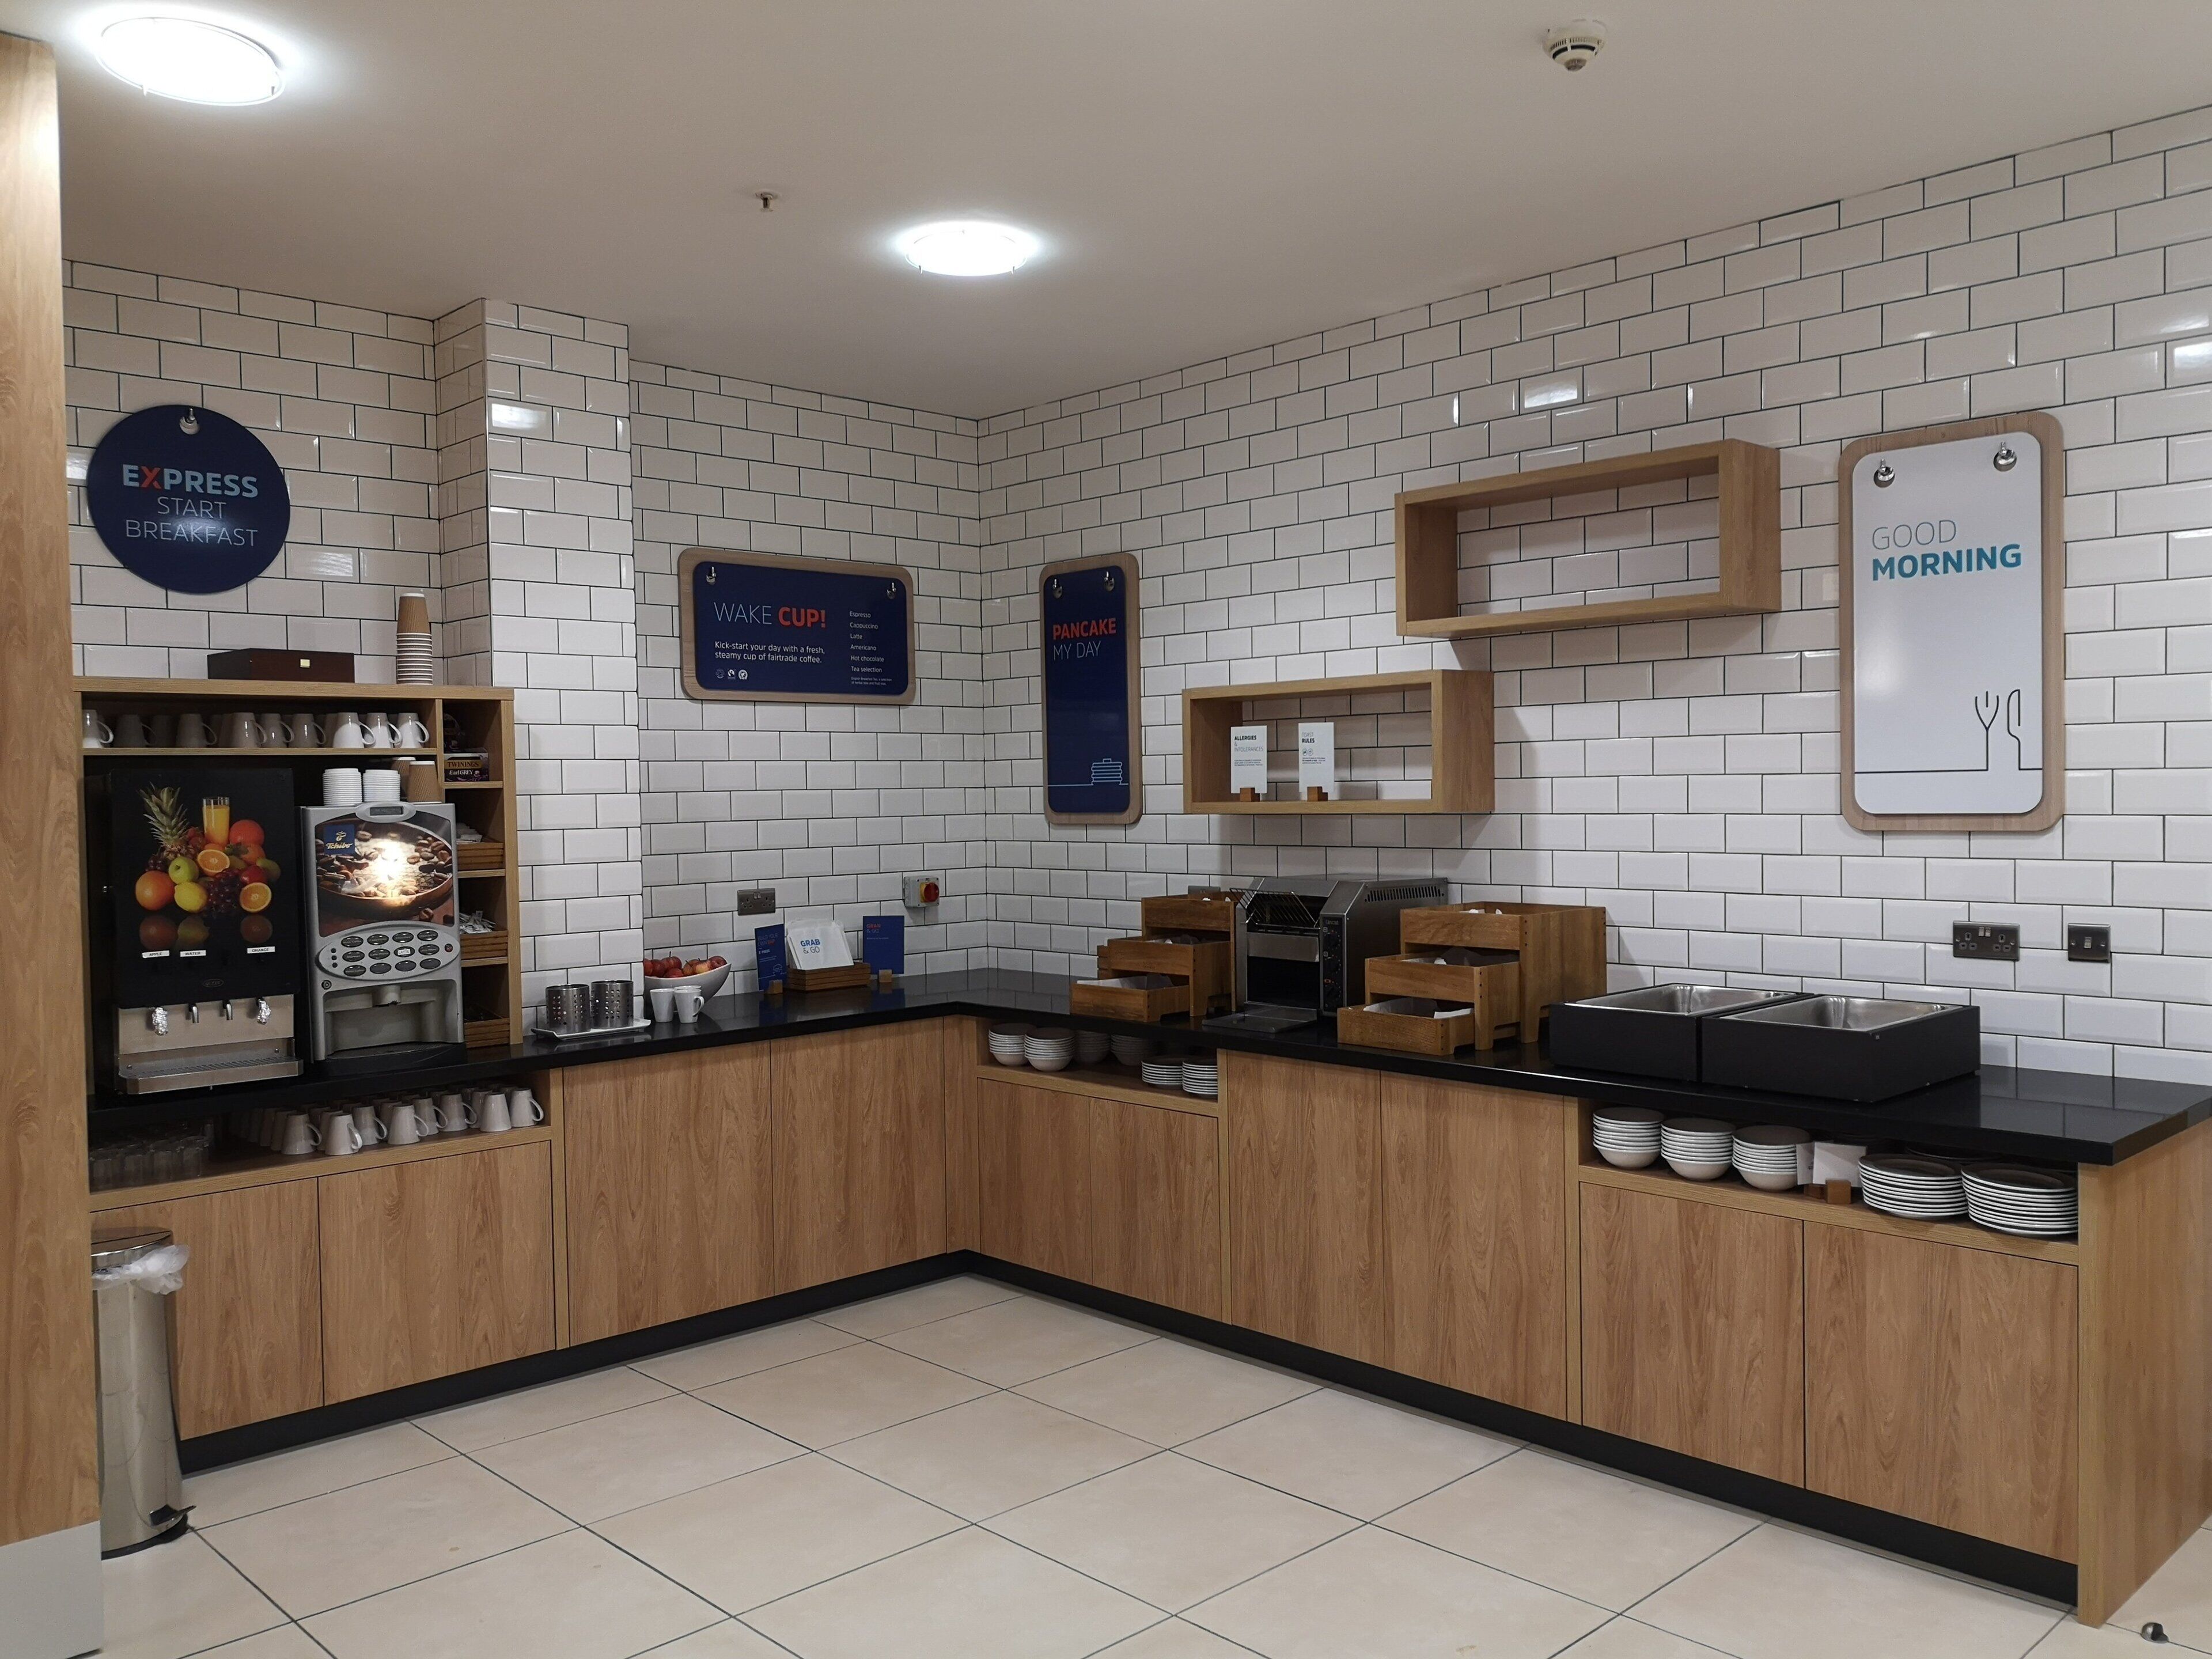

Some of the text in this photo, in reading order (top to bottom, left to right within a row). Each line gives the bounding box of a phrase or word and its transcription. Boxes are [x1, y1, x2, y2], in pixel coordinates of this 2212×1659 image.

[123, 464, 258, 498] EXPRESS
[157, 497, 226, 519] START
[126, 520, 258, 546] BREAKFAST
[1872, 520, 1956, 550] GOOD
[1872, 544, 2021, 581] MORNING
[714, 602, 825, 628] WAKE CUP!
[1053, 618, 1116, 641] PANCAKE
[715, 641, 748, 650] Kick-start
[768, 644, 781, 652] day
[715, 652, 741, 660] steamy
[768, 653, 798, 662] fairtrade
[1054, 641, 1101, 661] MY DAY
